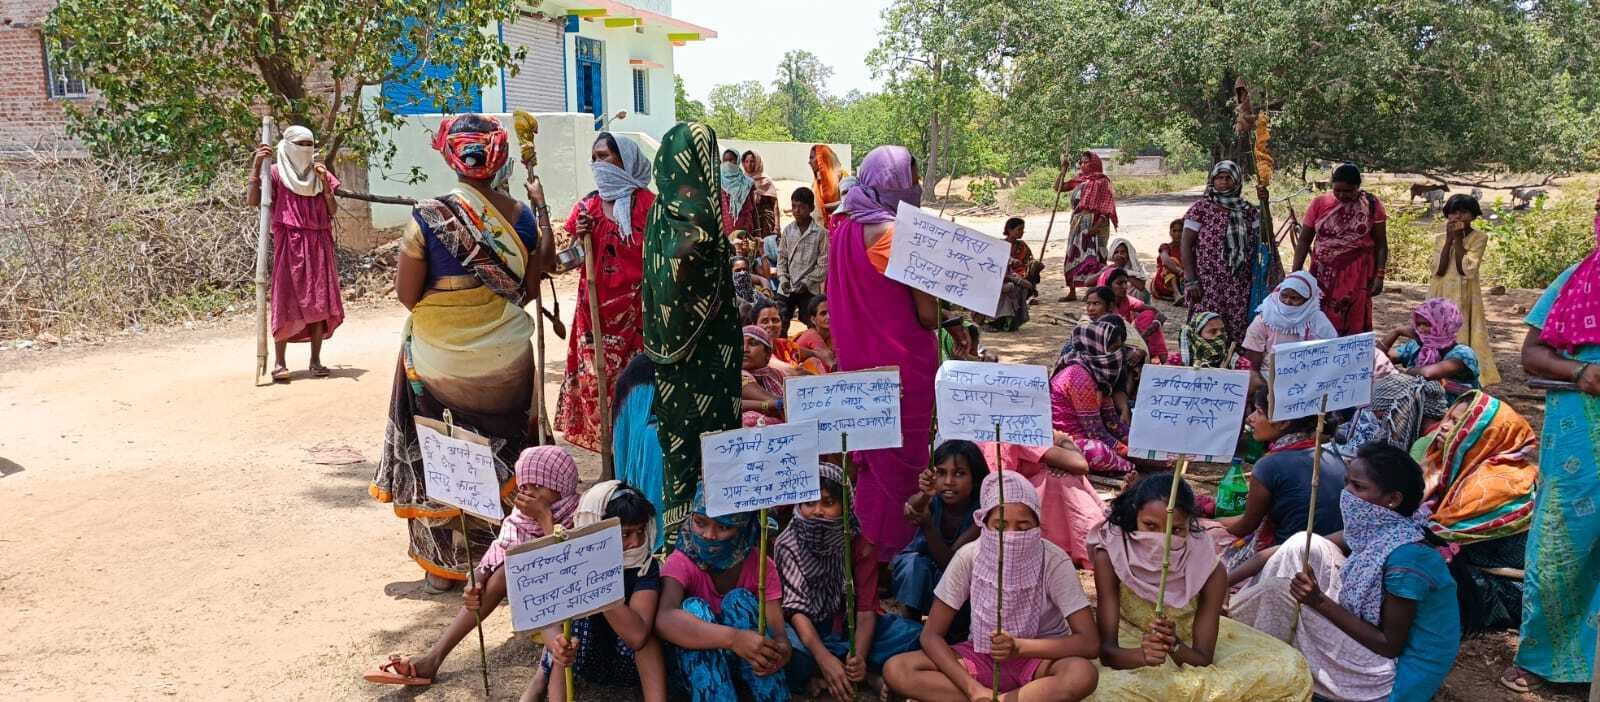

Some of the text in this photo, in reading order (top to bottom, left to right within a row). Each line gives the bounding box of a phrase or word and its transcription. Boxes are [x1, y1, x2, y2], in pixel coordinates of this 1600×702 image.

[946, 248, 974, 271] अमर
[1223, 383, 1243, 397] पर
[801, 397, 832, 410] 2006
[1187, 409, 1218, 430] करो
